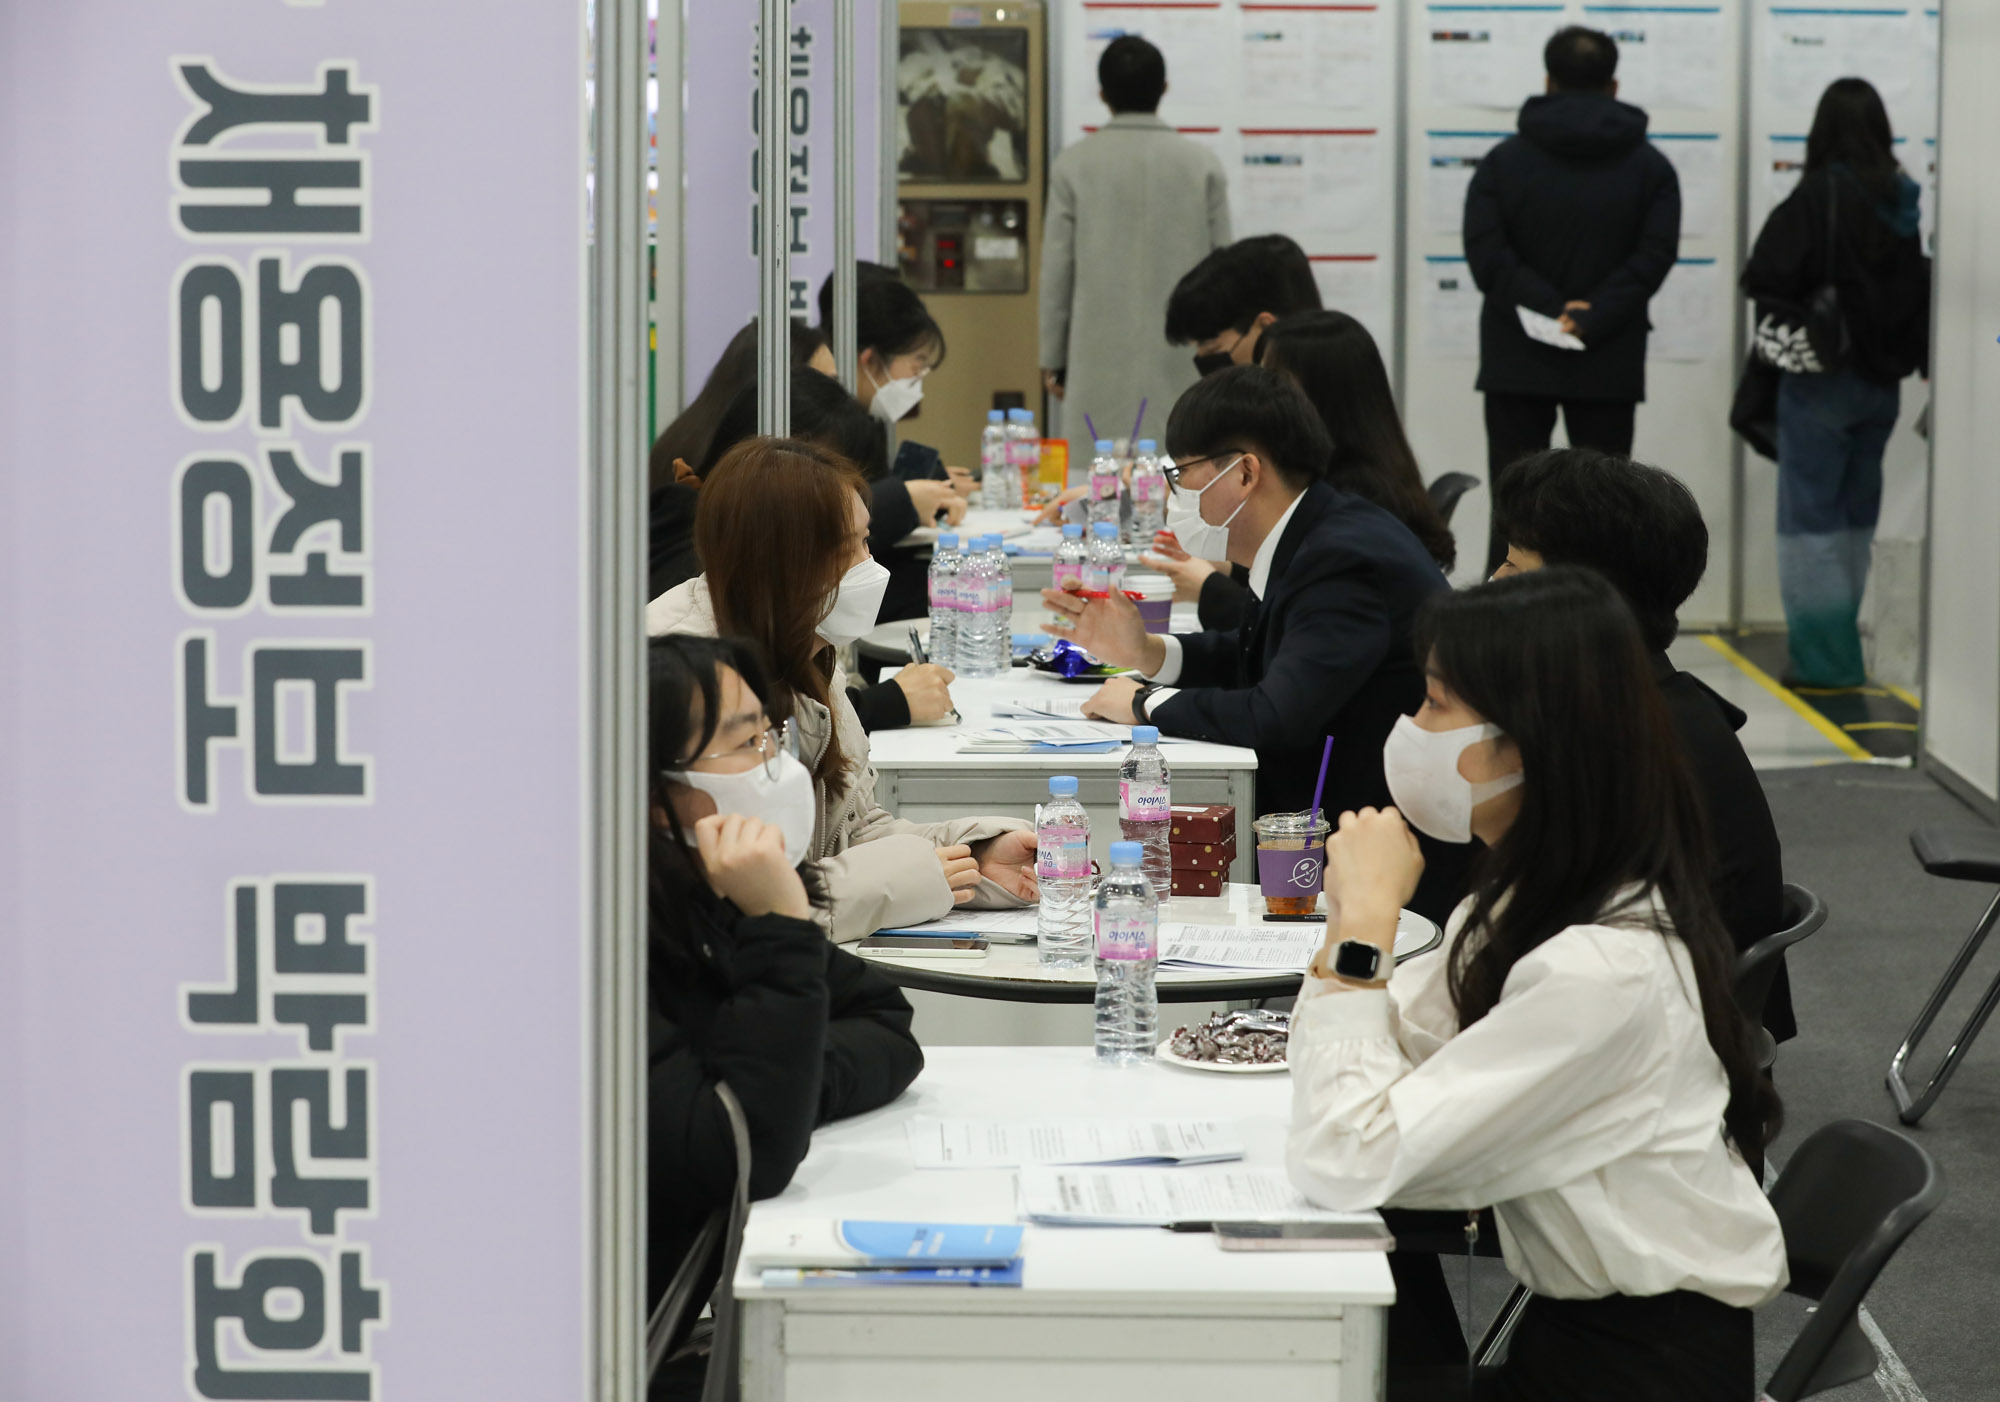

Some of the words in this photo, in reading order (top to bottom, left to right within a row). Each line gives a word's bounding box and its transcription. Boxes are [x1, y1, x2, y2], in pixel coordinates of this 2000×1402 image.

[174, 58, 376, 808] 채용정보
[1137, 796, 1167, 806] 아이시스
[1043, 860, 1053, 868] 8.0
[1108, 930, 1146, 942] 아이시스
[184, 876, 383, 1402] 박람회
